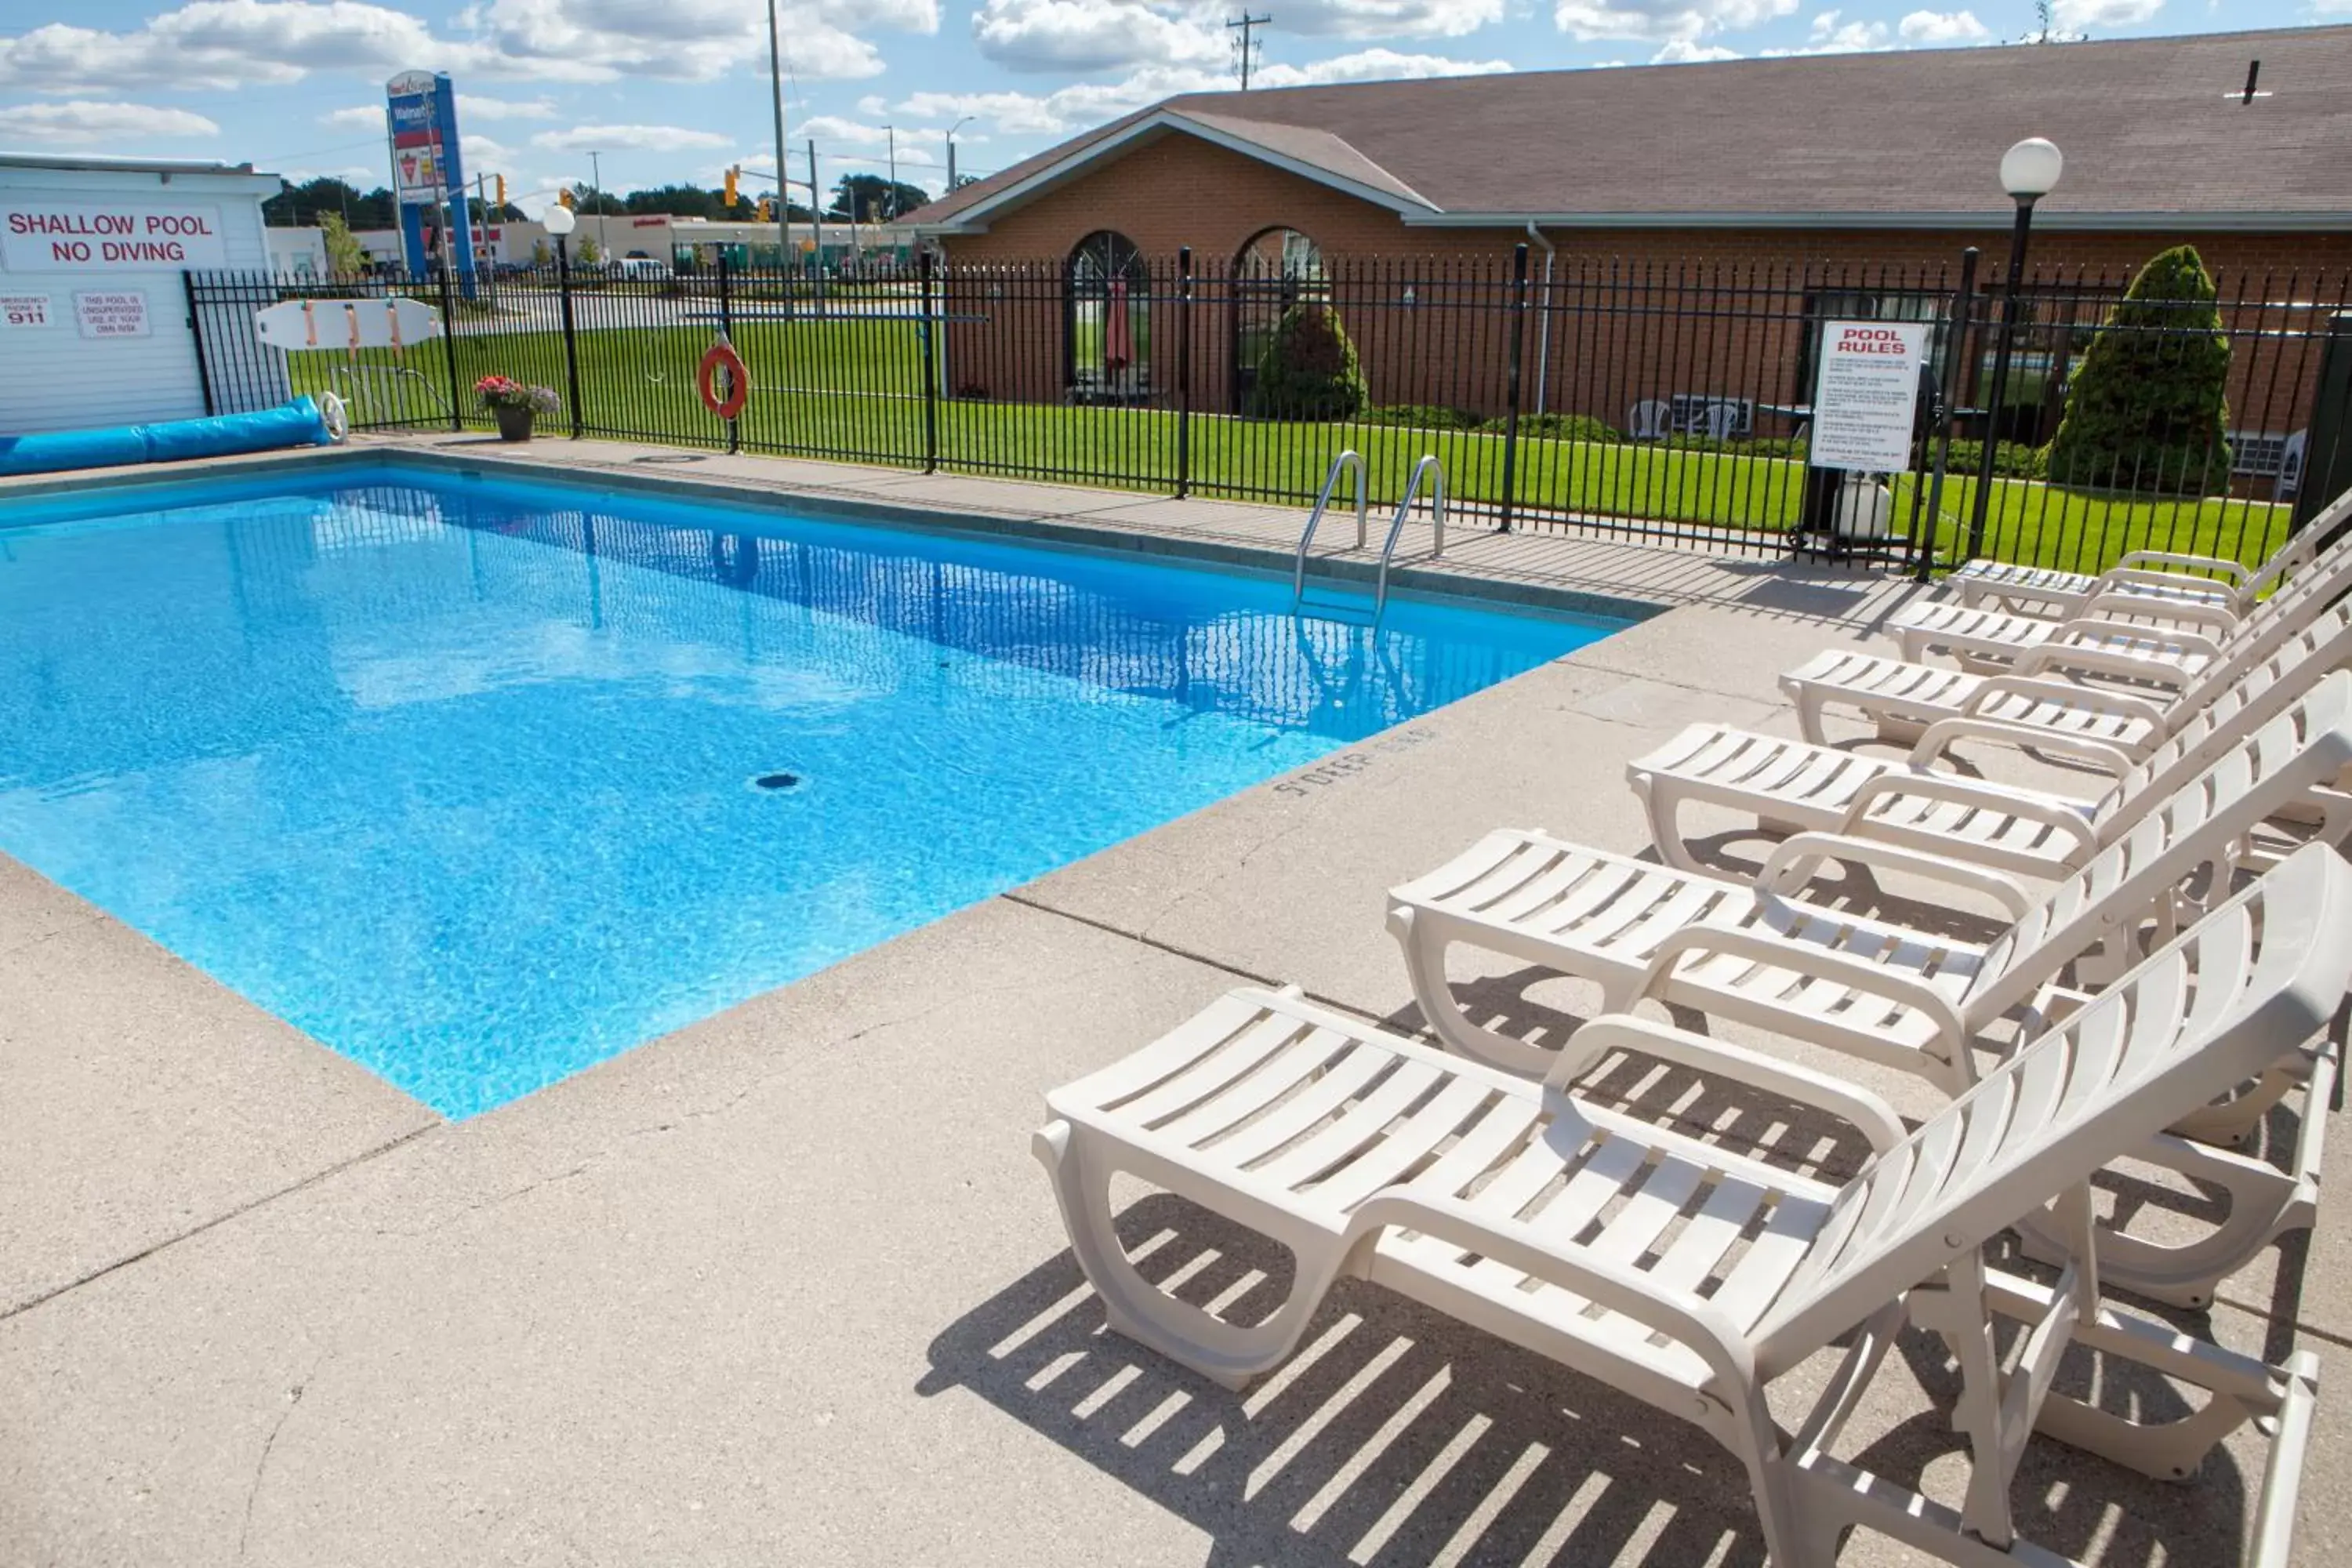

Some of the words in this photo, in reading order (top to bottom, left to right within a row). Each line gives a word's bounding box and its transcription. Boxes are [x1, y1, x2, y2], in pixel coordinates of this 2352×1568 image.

[8, 212, 134, 234] SHALLOW
[147, 216, 212, 235] POOL
[52, 241, 91, 261] NO
[102, 242, 185, 261] DIVING
[8, 313, 44, 324] 911
[1843, 328, 1902, 341] POOL
[1837, 342, 1906, 354] RULES
